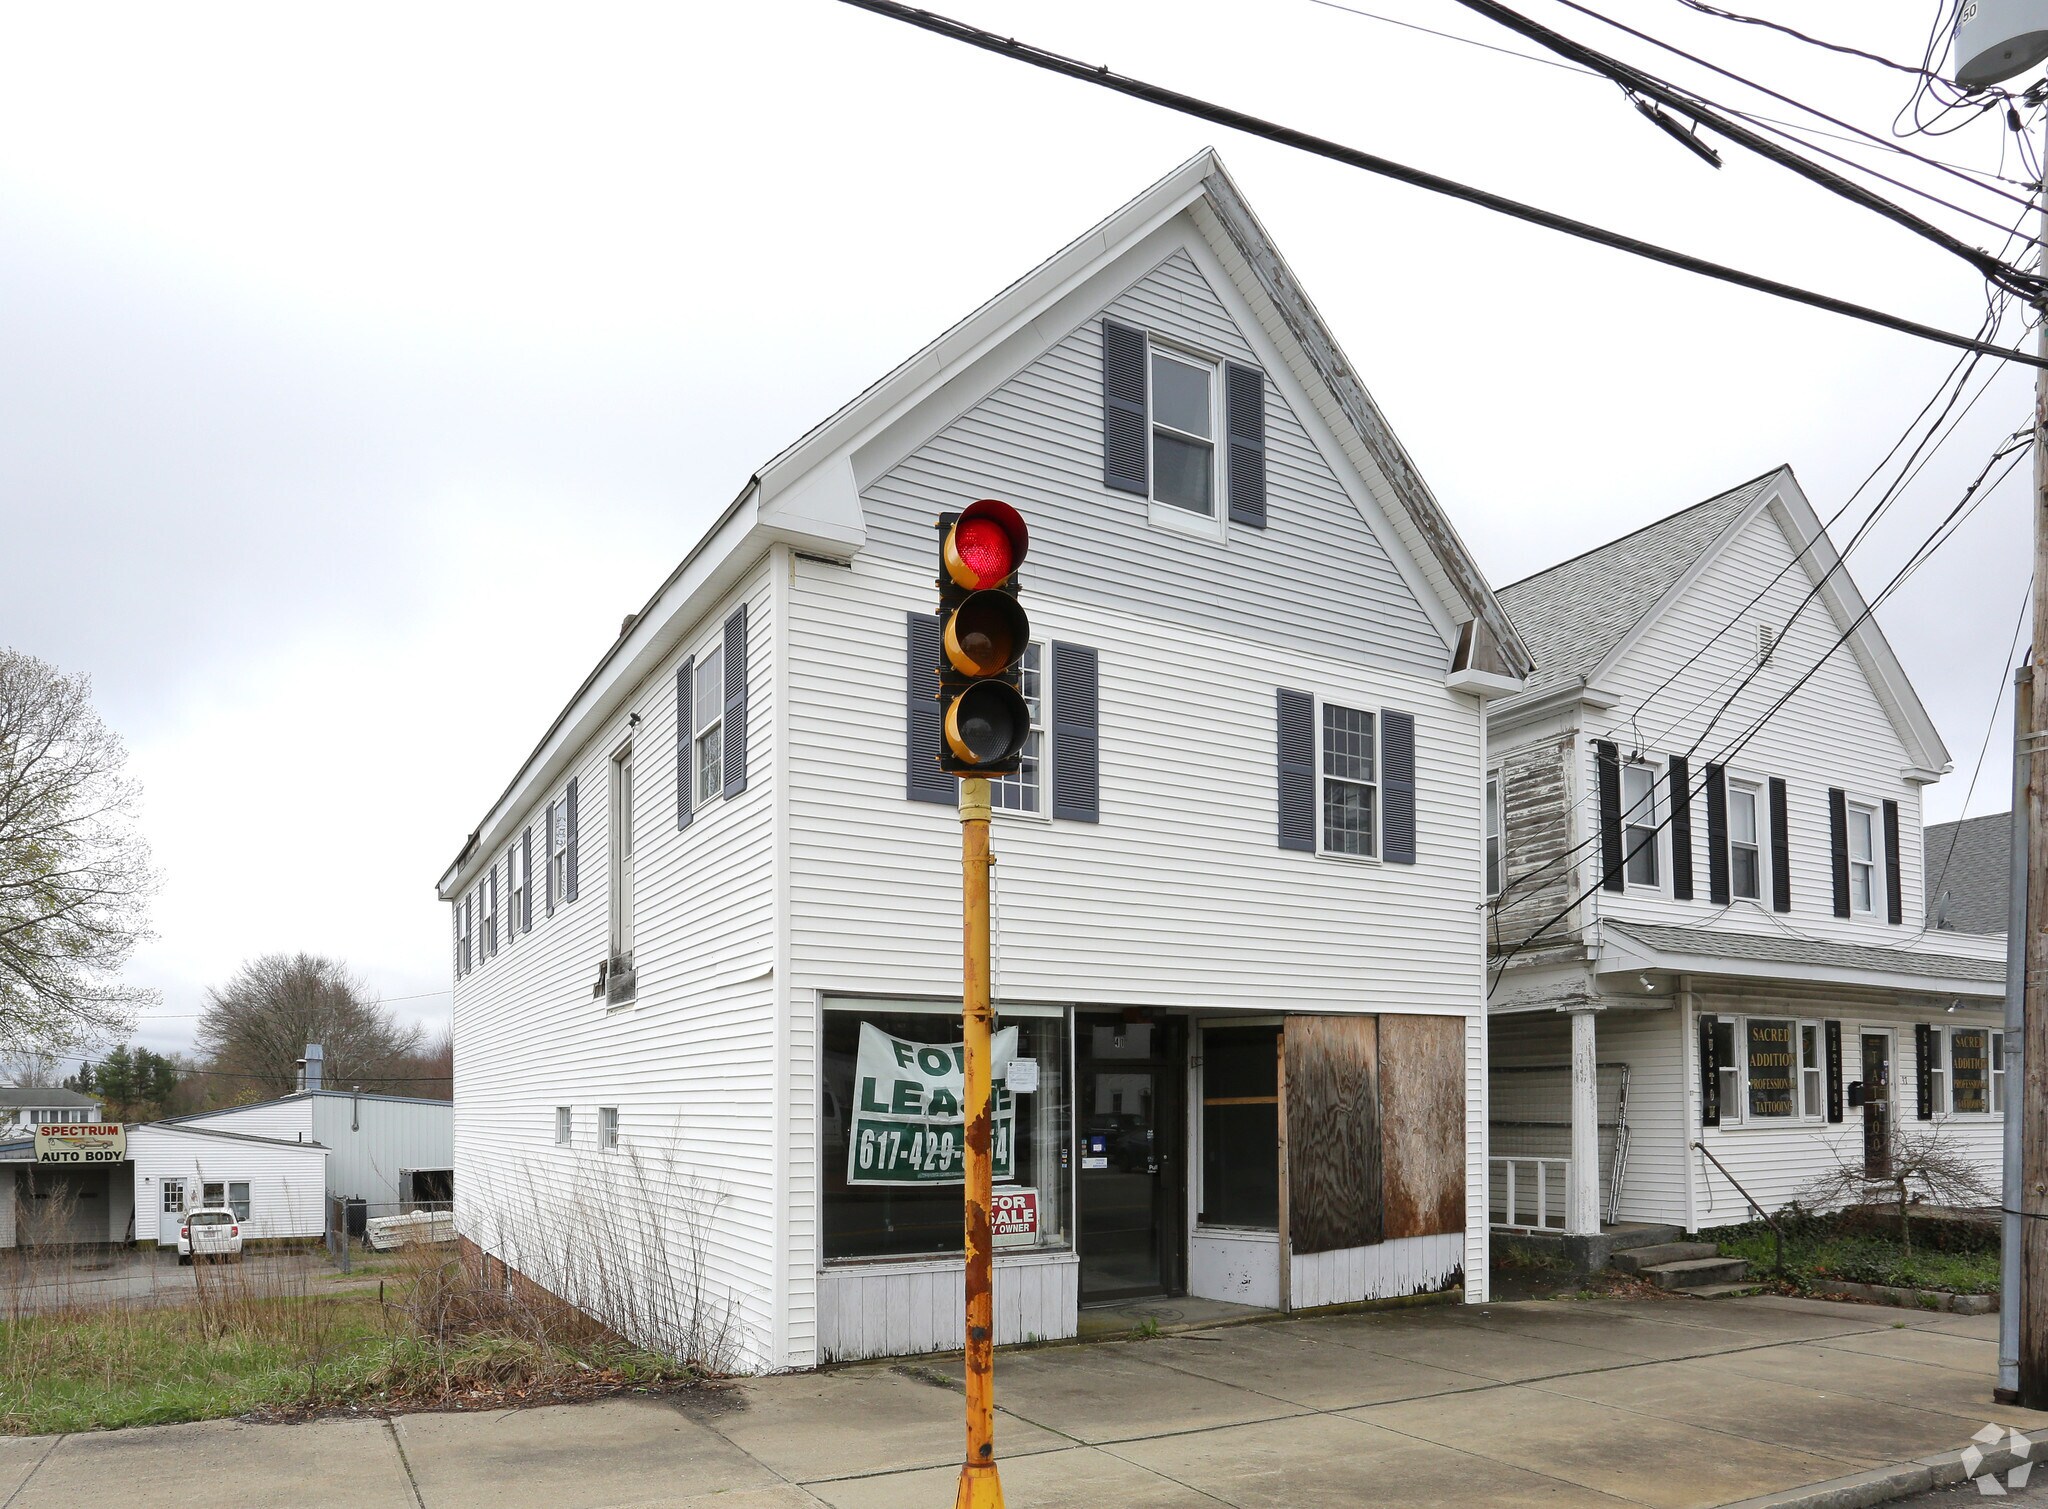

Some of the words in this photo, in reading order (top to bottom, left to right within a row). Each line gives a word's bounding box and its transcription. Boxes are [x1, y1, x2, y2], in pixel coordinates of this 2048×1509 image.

[1963, 4, 1976, 22] 50
[1753, 1027, 1791, 1042] SACRED
[1955, 1035, 1984, 1048] SACRED
[1750, 1053, 1797, 1067] ADDITION
[860, 1077, 1012, 1117] LEAE
[1872, 1051, 1880, 1151] TATTOO
[1756, 1101, 1793, 1113] TATTOOING
[41, 1125, 119, 1136] SPECTRUM
[41, 1152, 80, 1162] AUTO
[85, 1151, 122, 1161] BODY
[999, 1223, 1030, 1233] OWNER
